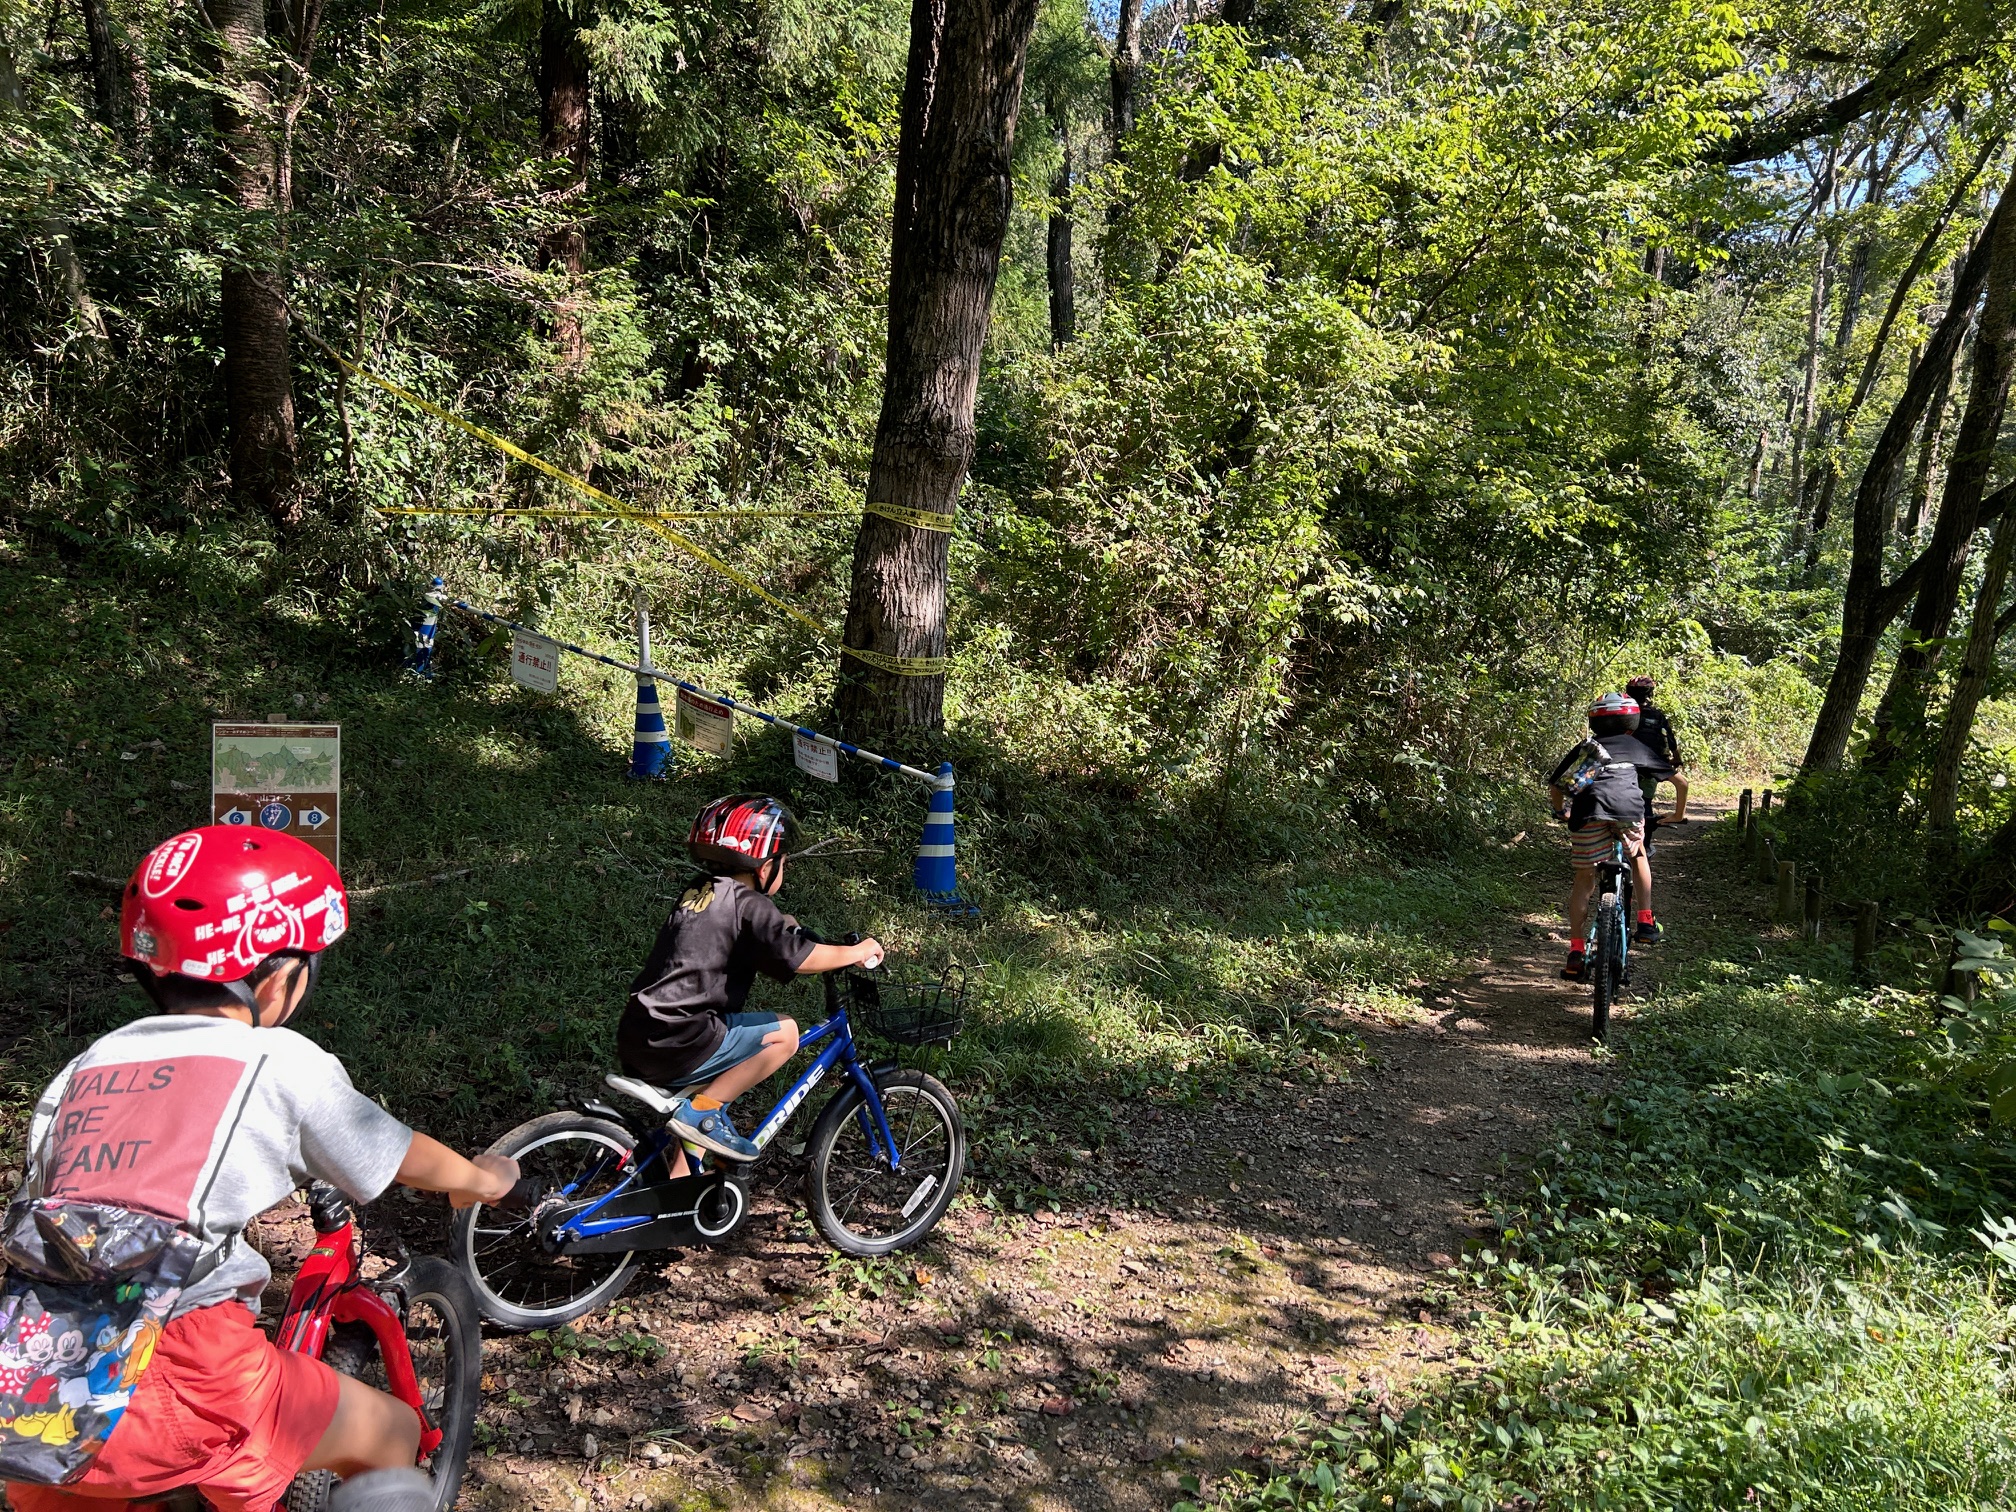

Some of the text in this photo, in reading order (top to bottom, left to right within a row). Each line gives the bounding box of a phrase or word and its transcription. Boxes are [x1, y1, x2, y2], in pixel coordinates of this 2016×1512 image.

[233, 813, 240, 823] 6
[270, 809, 283, 826] 7
[310, 813, 319, 823] 8
[47, 1105, 109, 1143] ARE
[54, 1140, 152, 1178] EANT
